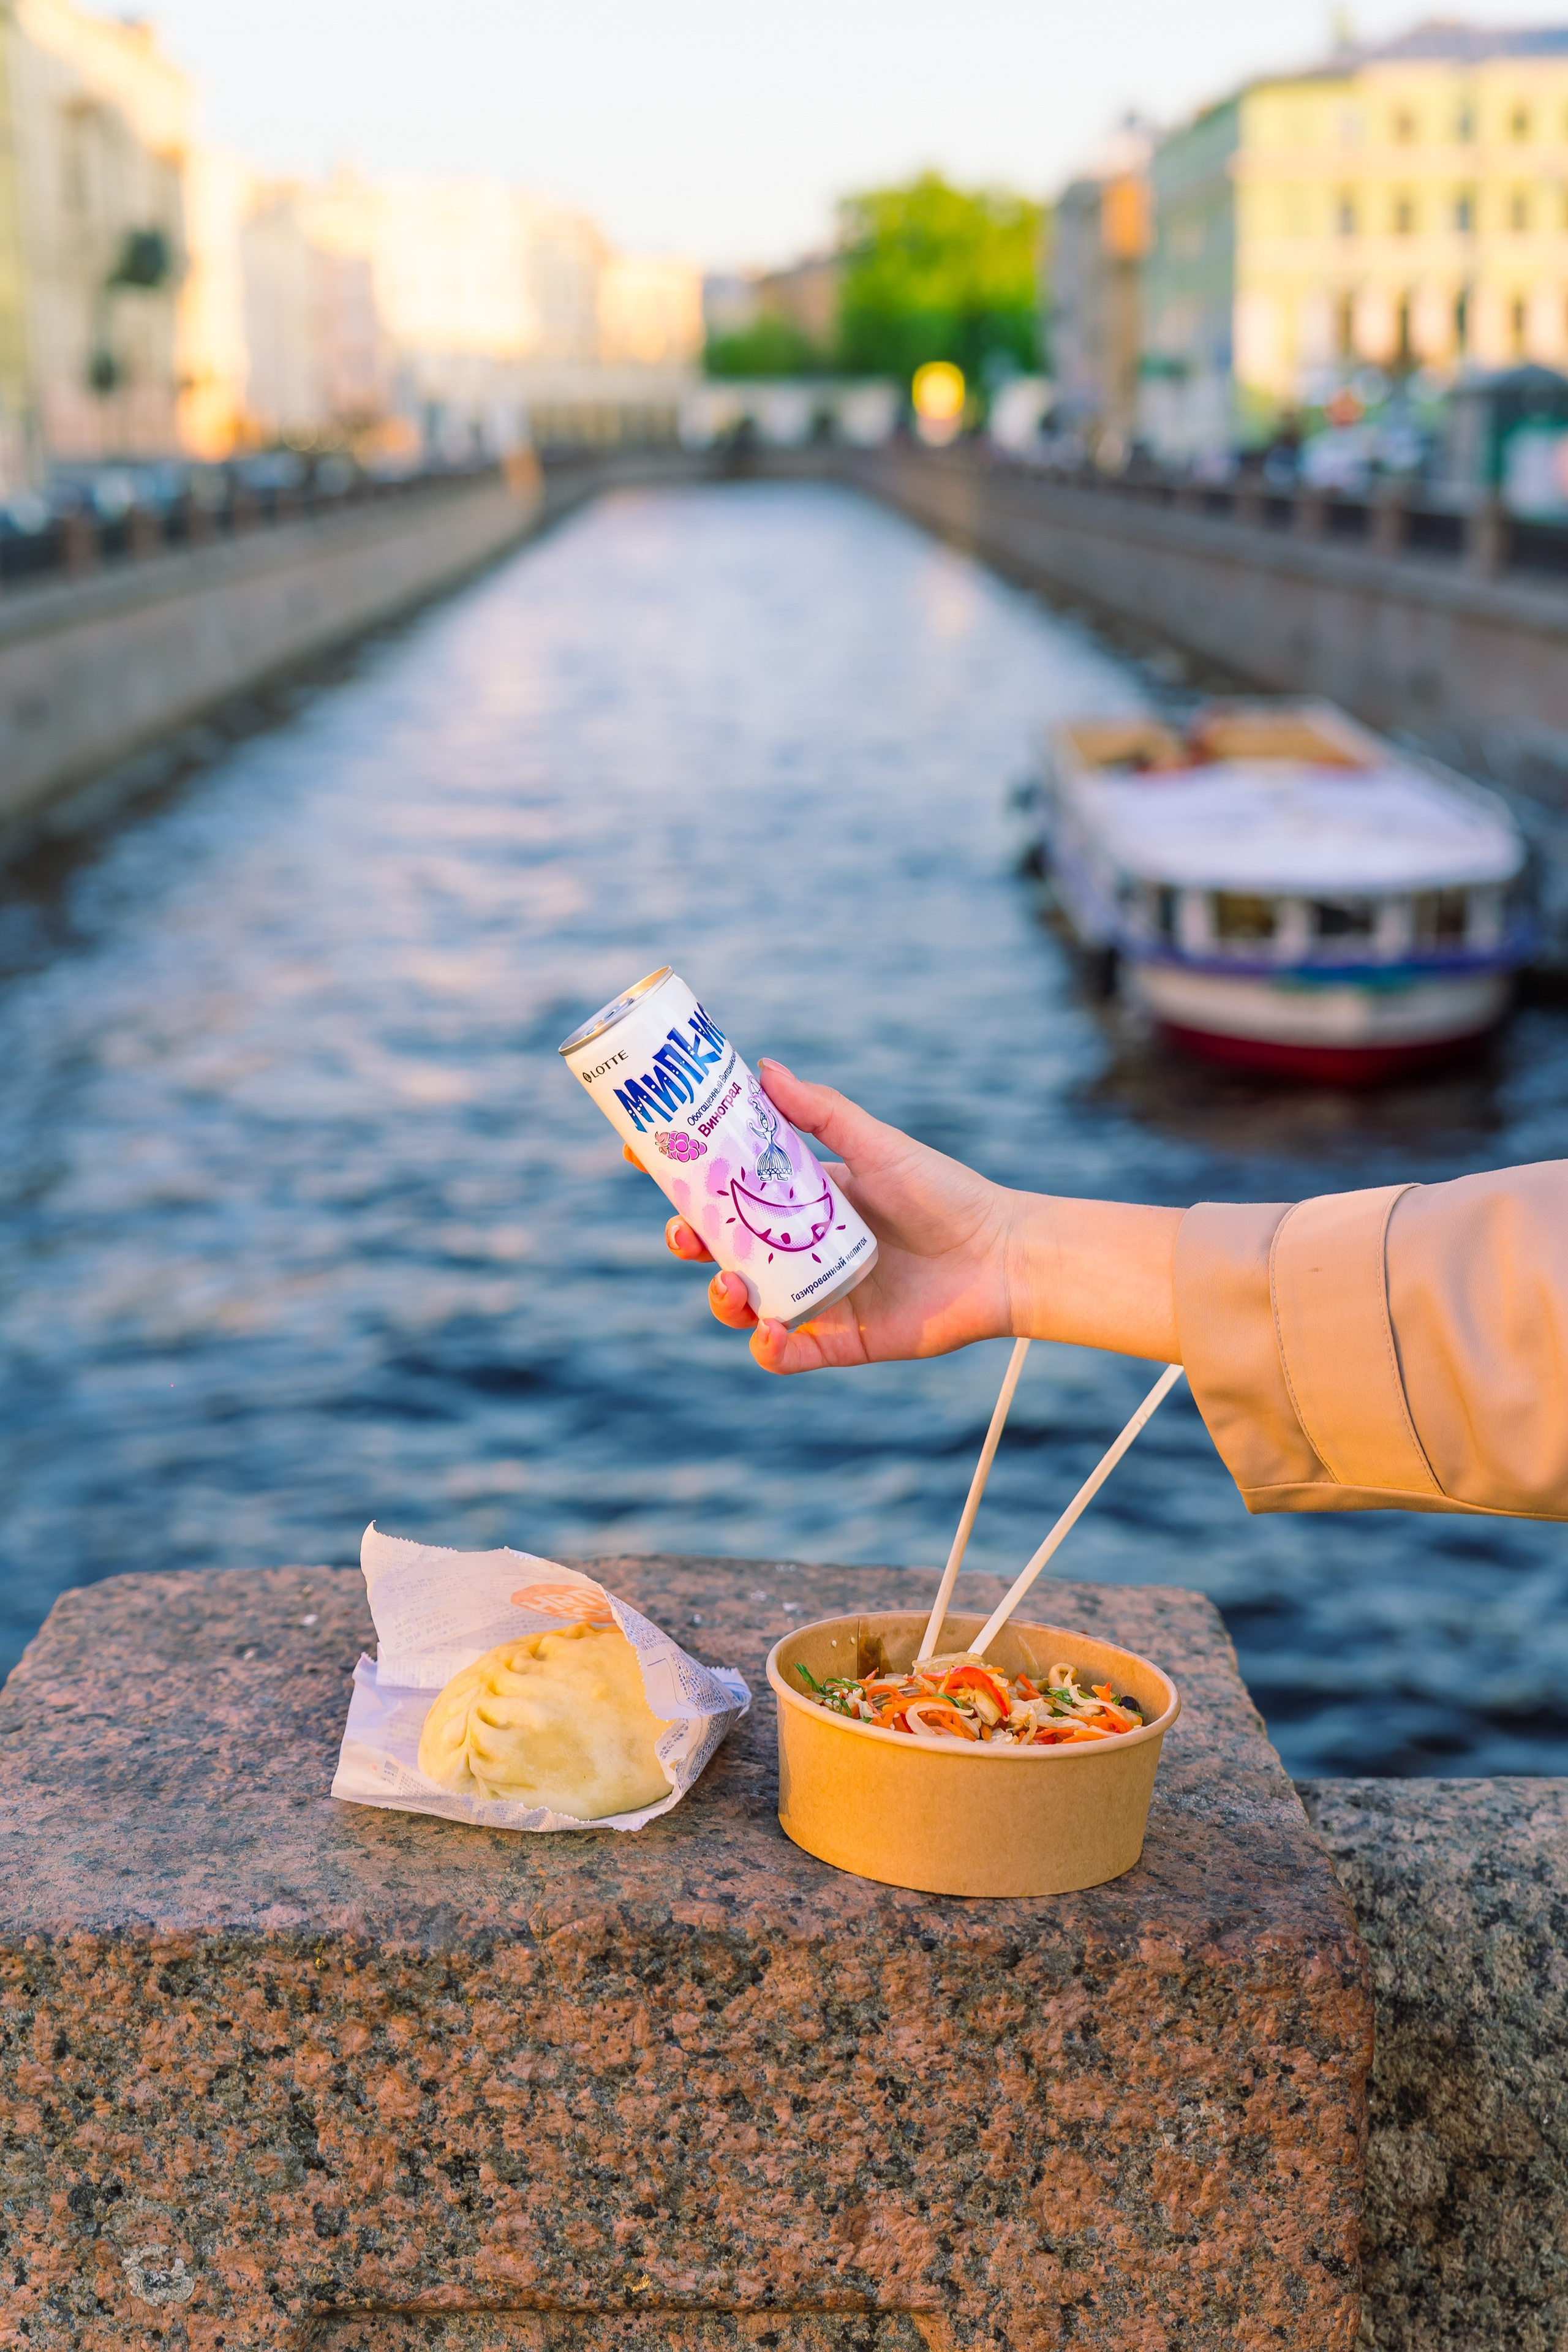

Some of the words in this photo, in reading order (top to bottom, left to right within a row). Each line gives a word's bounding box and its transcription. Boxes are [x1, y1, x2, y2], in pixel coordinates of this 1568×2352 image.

[590, 1049, 629, 1078] LOTTE
[687, 1080, 725, 1126] Обогащенный
[697, 1082, 742, 1137] Виноград
[791, 1256, 846, 1302] Газированный
[845, 1236, 868, 1262] напиток
